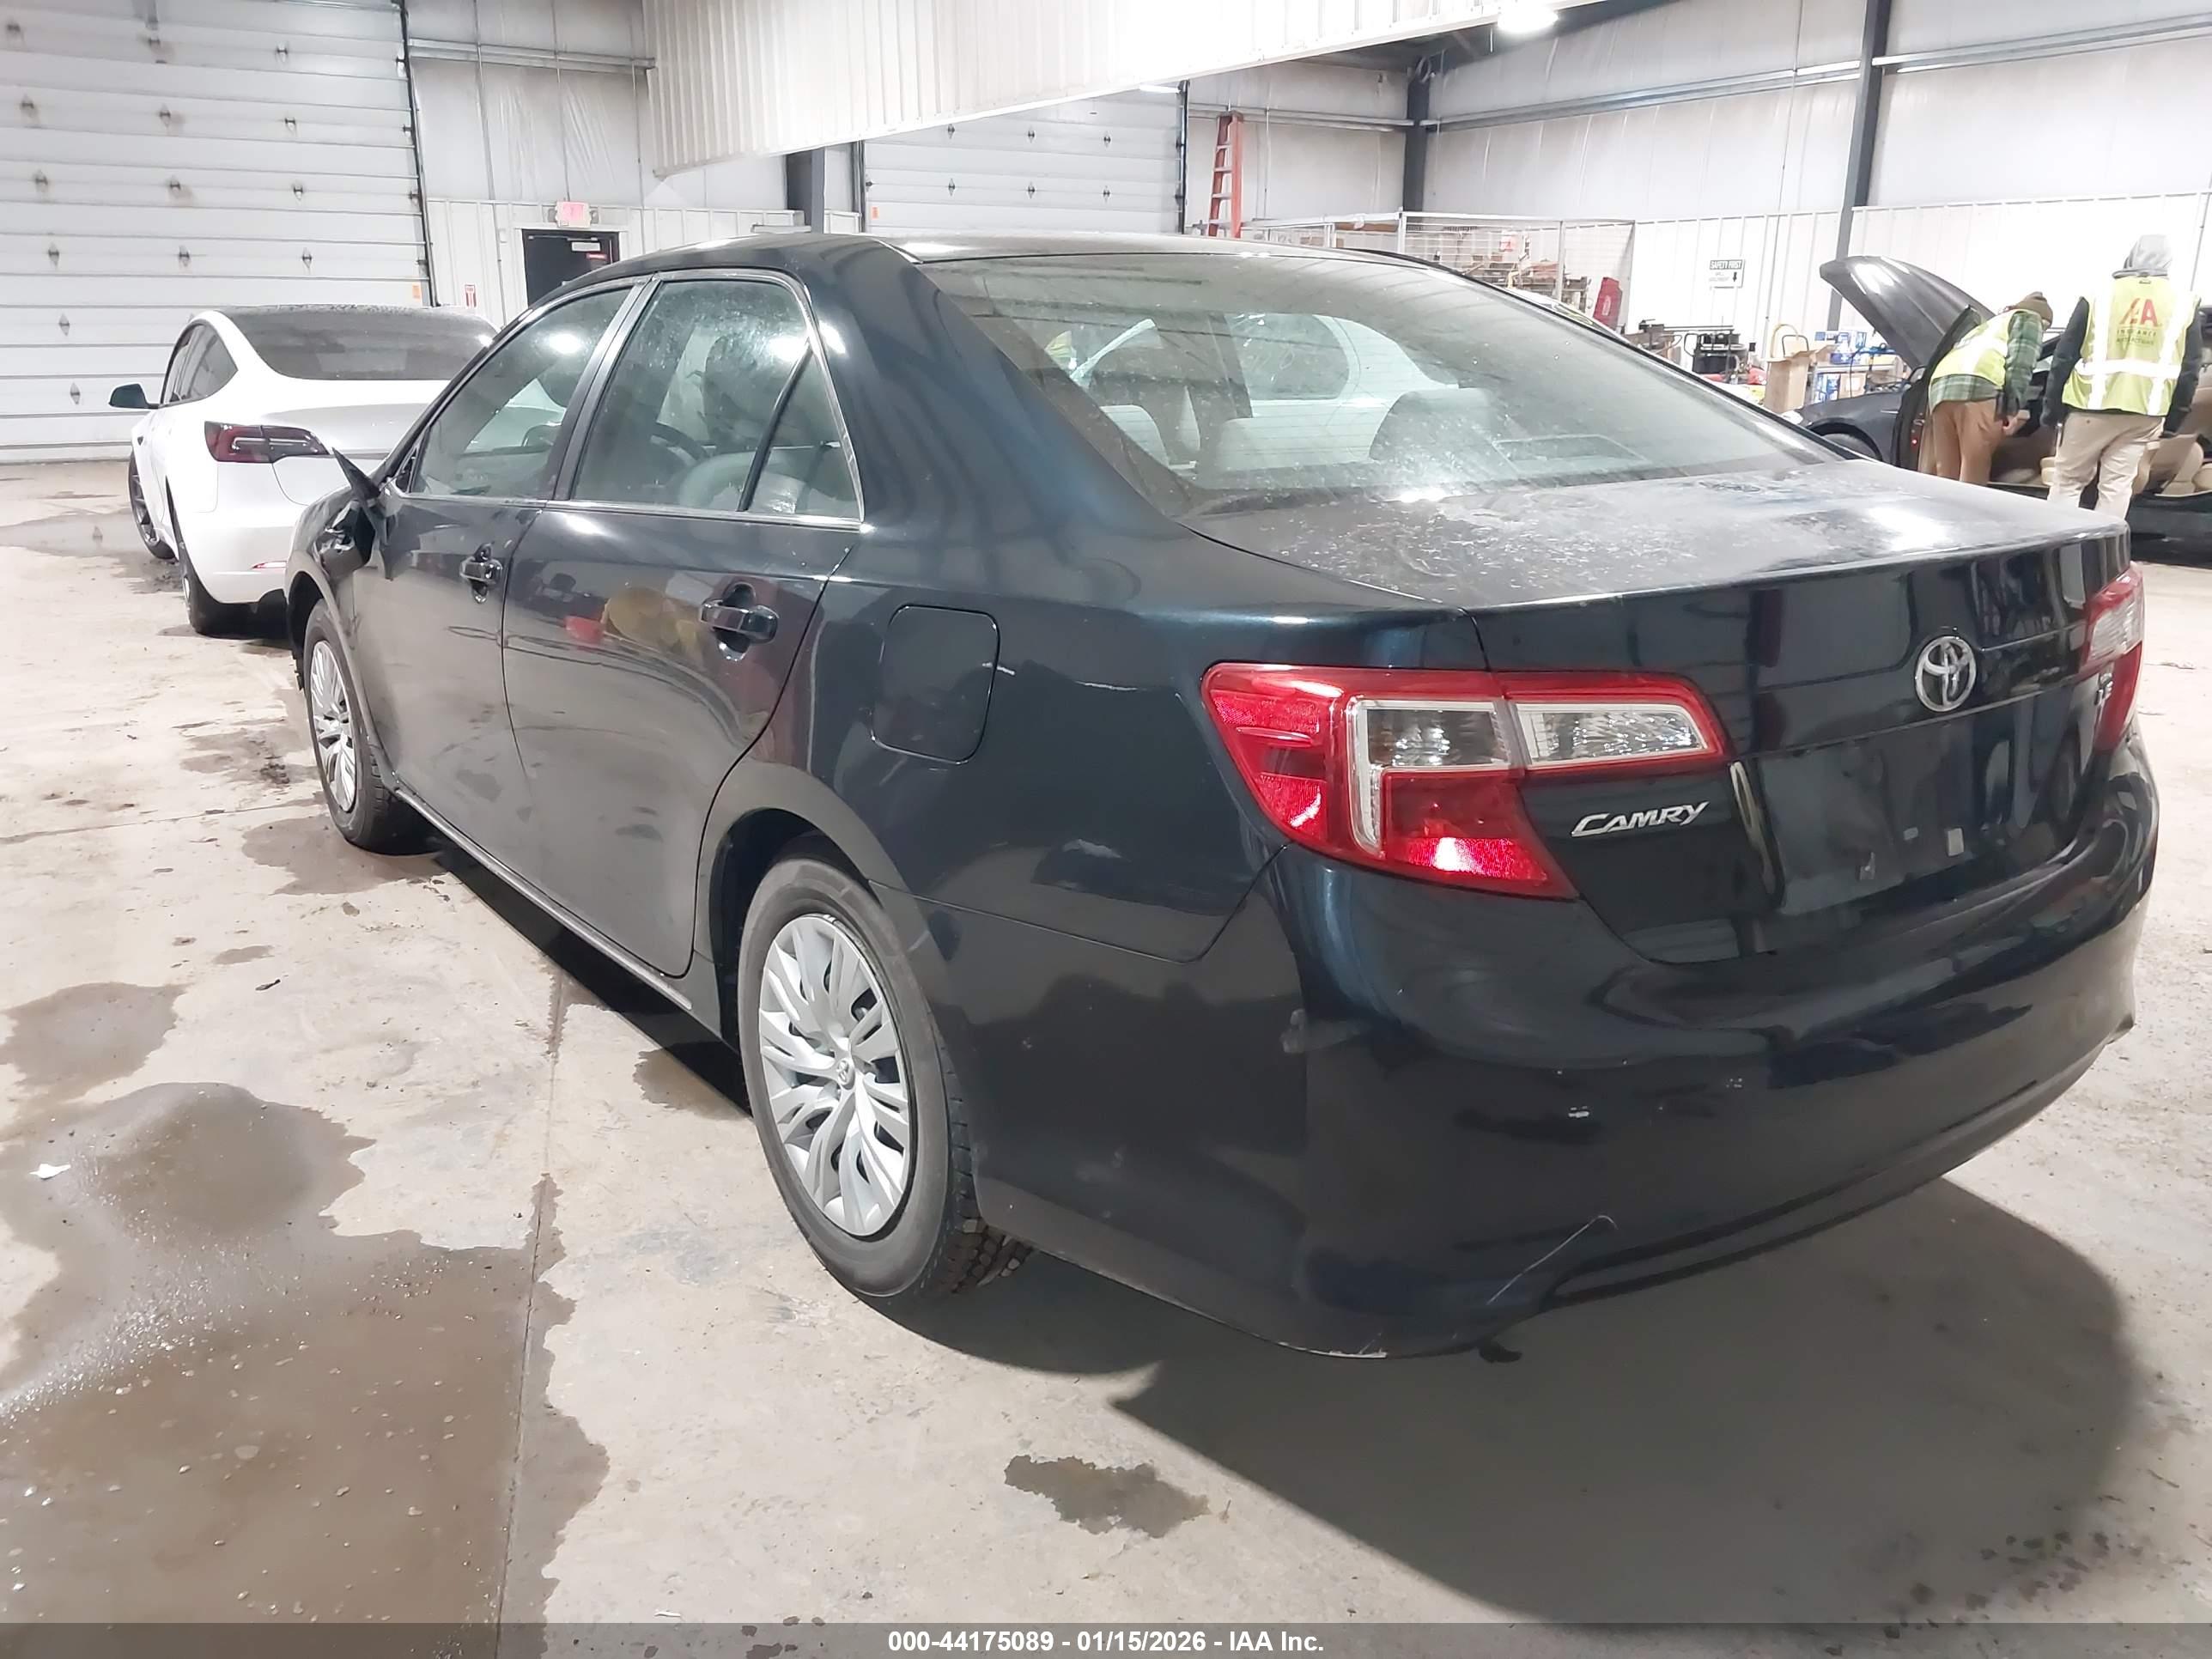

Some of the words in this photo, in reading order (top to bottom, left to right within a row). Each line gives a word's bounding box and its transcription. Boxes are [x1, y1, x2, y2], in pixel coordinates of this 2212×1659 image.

[1710, 260, 1729, 270] SAFETY
[1729, 260, 1742, 269] FIRST
[1571, 800, 1711, 838] CAMRY
